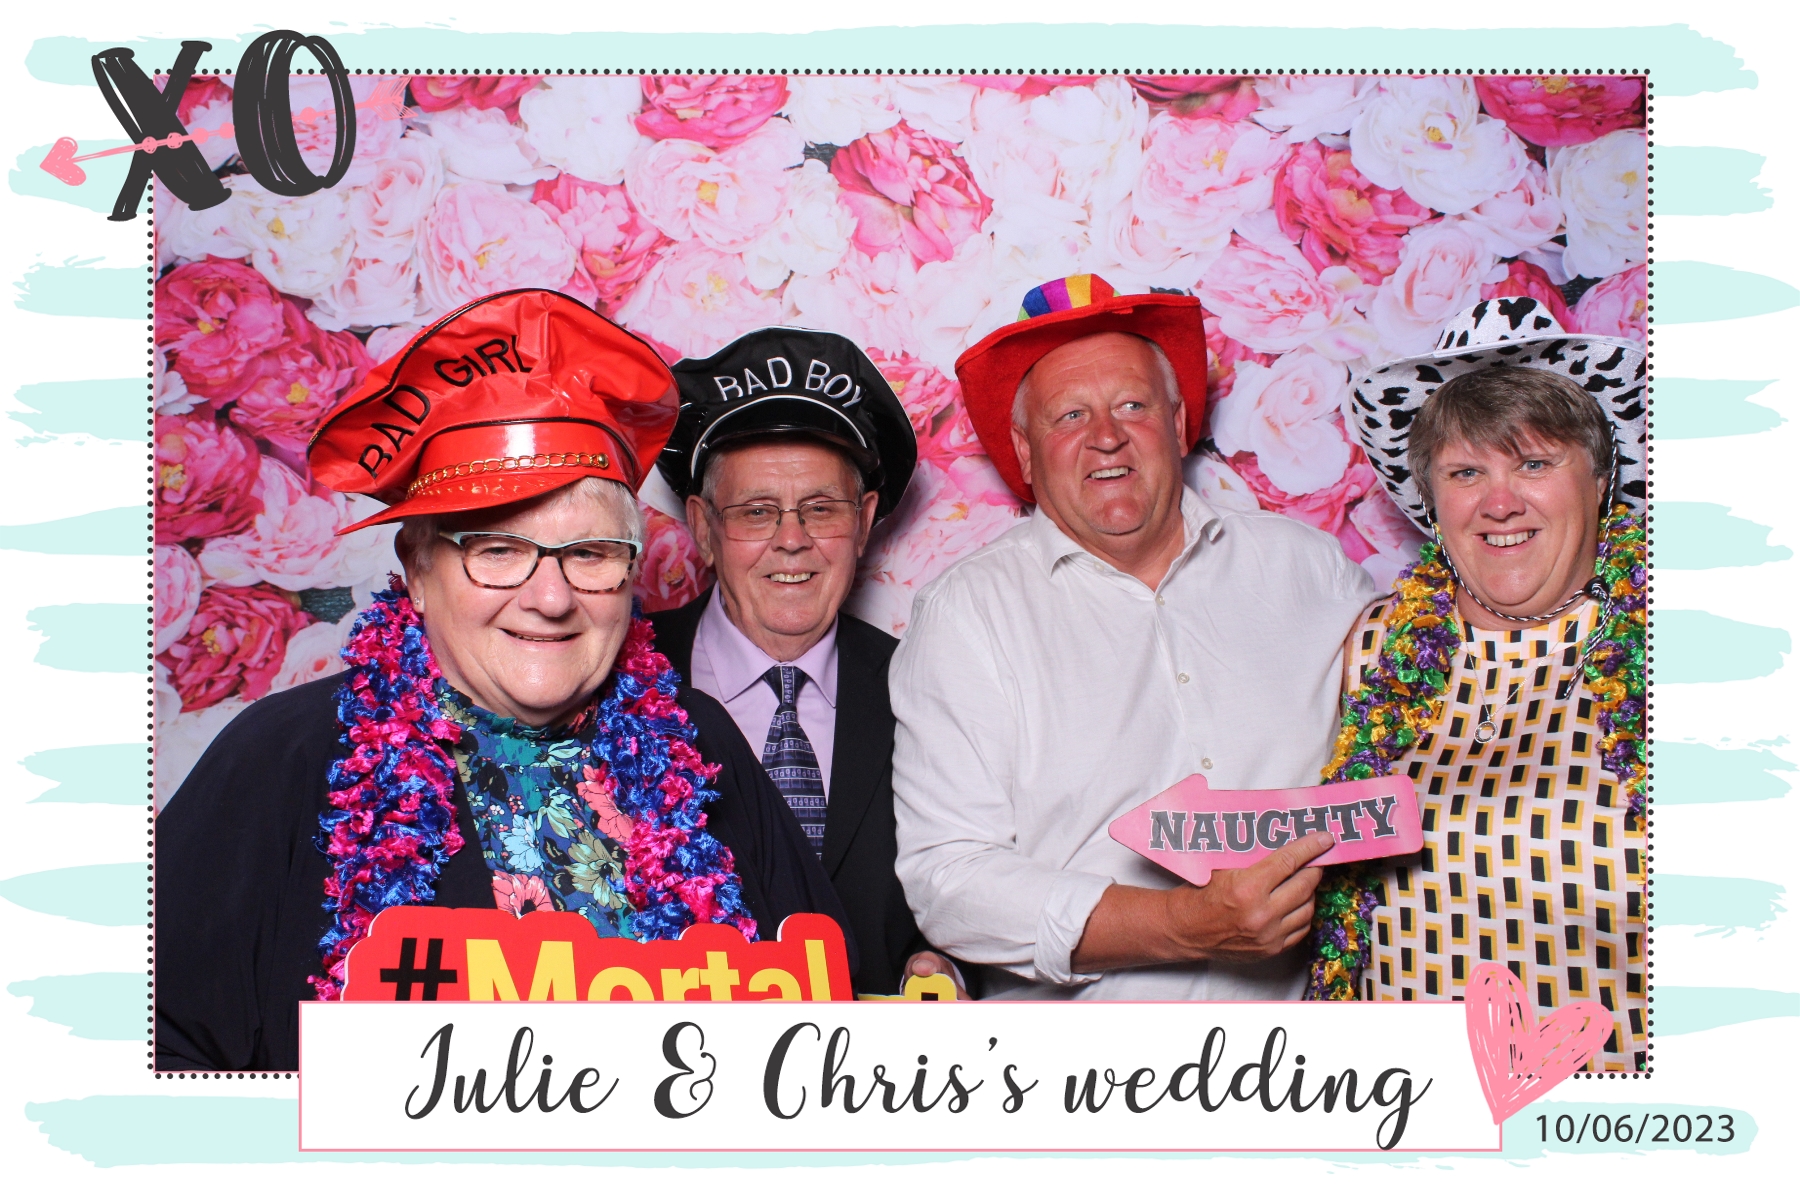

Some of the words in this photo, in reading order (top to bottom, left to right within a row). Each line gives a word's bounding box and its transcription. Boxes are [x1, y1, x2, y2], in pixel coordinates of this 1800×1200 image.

[358, 384, 431, 479] BAD
[434, 335, 533, 387] GIRL
[713, 356, 793, 401] BAD
[805, 358, 867, 408] BOY
[1148, 794, 1397, 853] NAUGHTY
